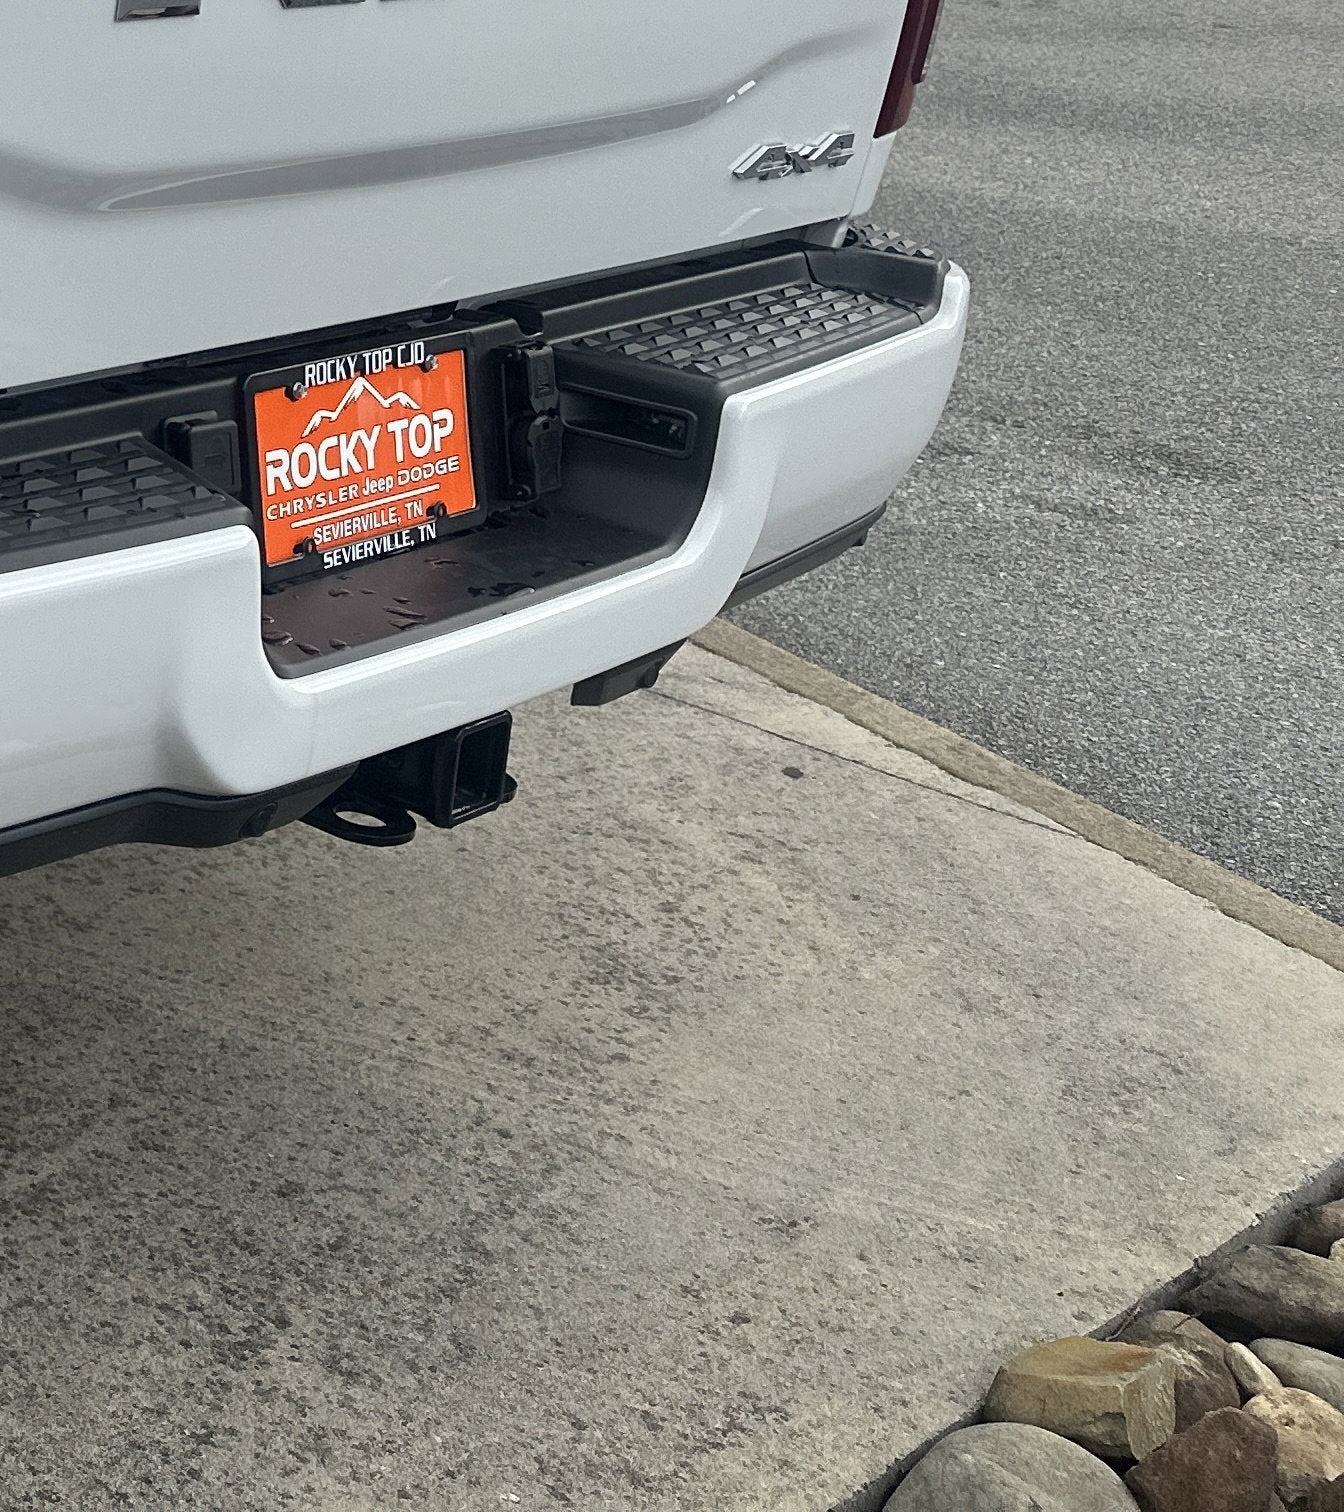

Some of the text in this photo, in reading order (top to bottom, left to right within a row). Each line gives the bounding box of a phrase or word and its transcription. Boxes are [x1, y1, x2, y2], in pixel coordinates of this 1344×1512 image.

[305, 341, 425, 388] ROCKY TOP CJD
[265, 407, 455, 496] ROCKY TOP
[266, 455, 460, 521] CHRYSLER Jeep DODGE
[313, 500, 424, 546] SEVIERVILLE, TN
[323, 523, 437, 570] SEVIERVILLE, TN
